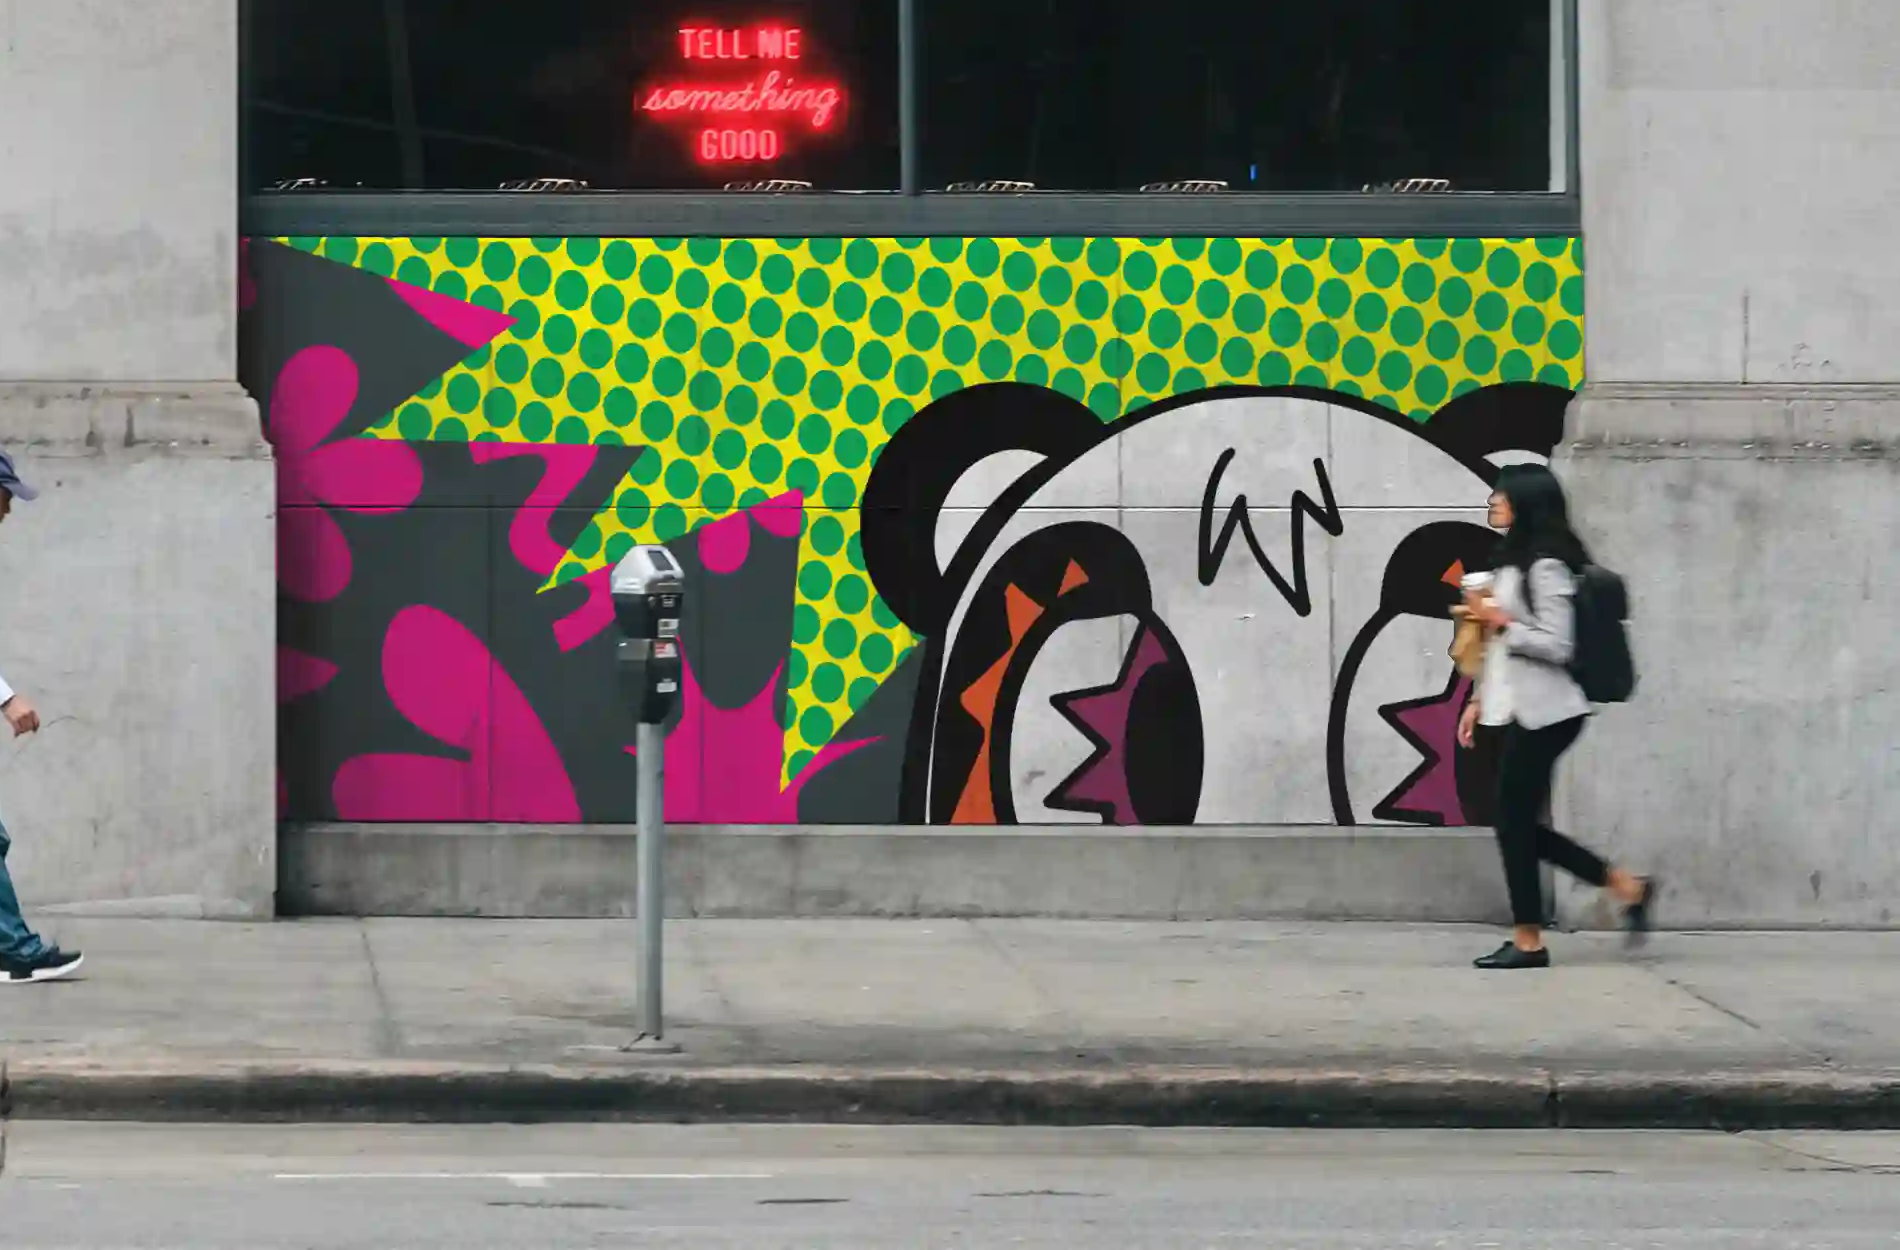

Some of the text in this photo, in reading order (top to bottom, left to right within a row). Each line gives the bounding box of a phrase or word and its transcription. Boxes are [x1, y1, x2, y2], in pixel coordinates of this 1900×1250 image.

[678, 28, 801, 59] TELL ME
[641, 70, 840, 126] something
[700, 129, 777, 160] GOOD
